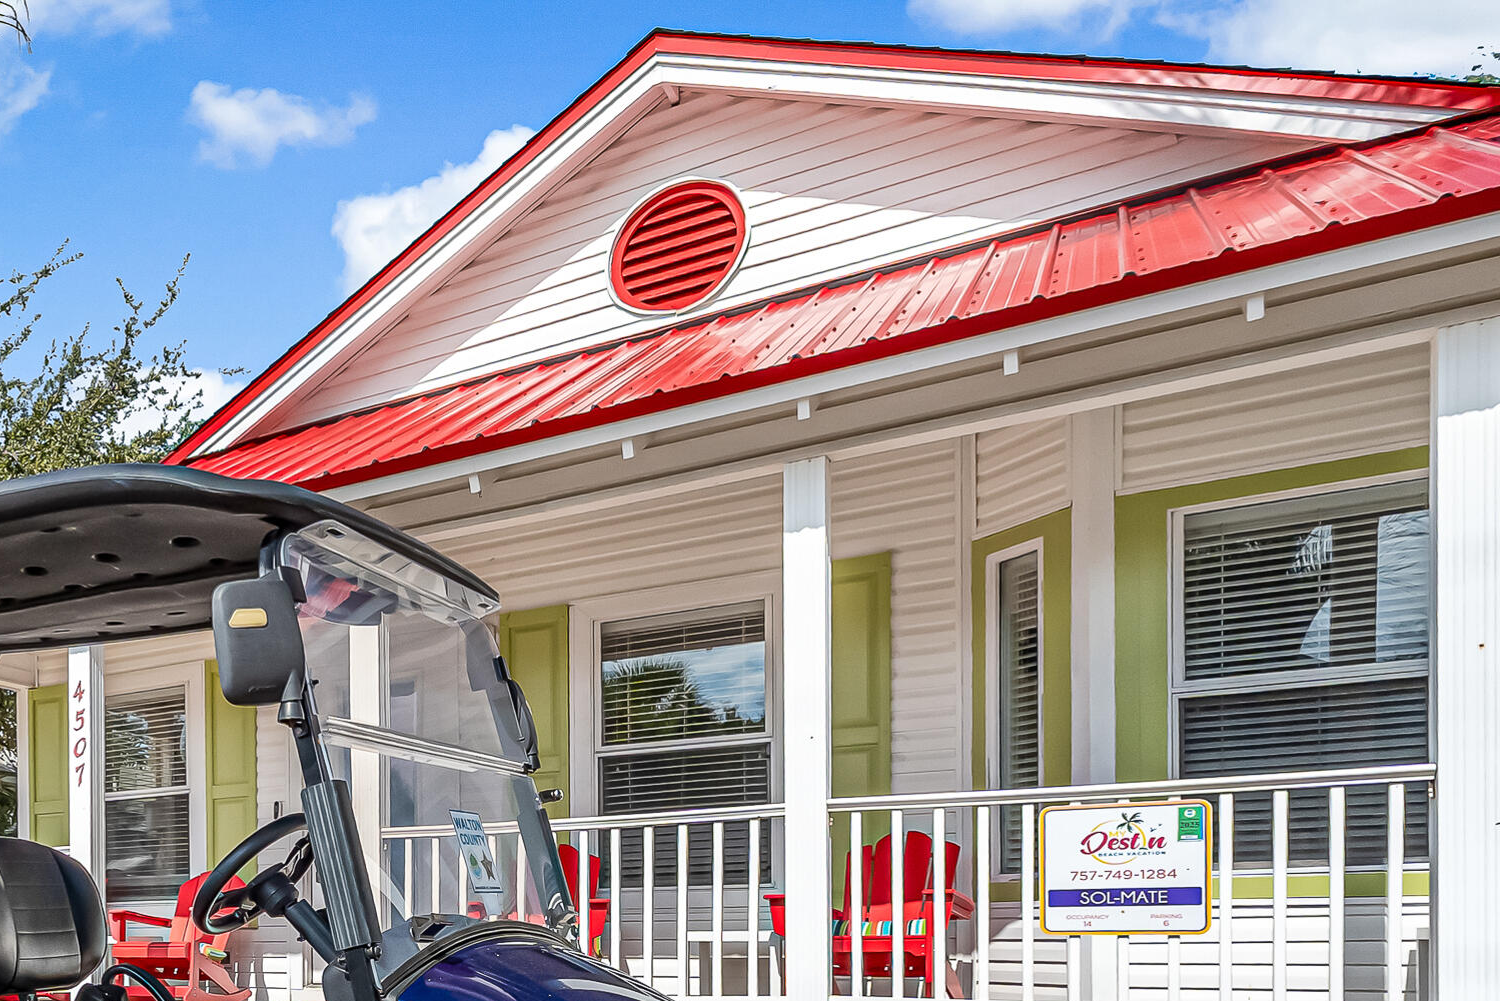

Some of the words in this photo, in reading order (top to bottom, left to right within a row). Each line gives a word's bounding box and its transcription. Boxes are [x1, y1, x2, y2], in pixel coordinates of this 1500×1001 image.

[72, 680, 87, 787] 4507
[453, 817, 483, 831] WALTON
[460, 833, 486, 846] COUNTY
[1070, 868, 1178, 881] 757-749-1284
[1079, 890, 1169, 905] SOL-MATE
